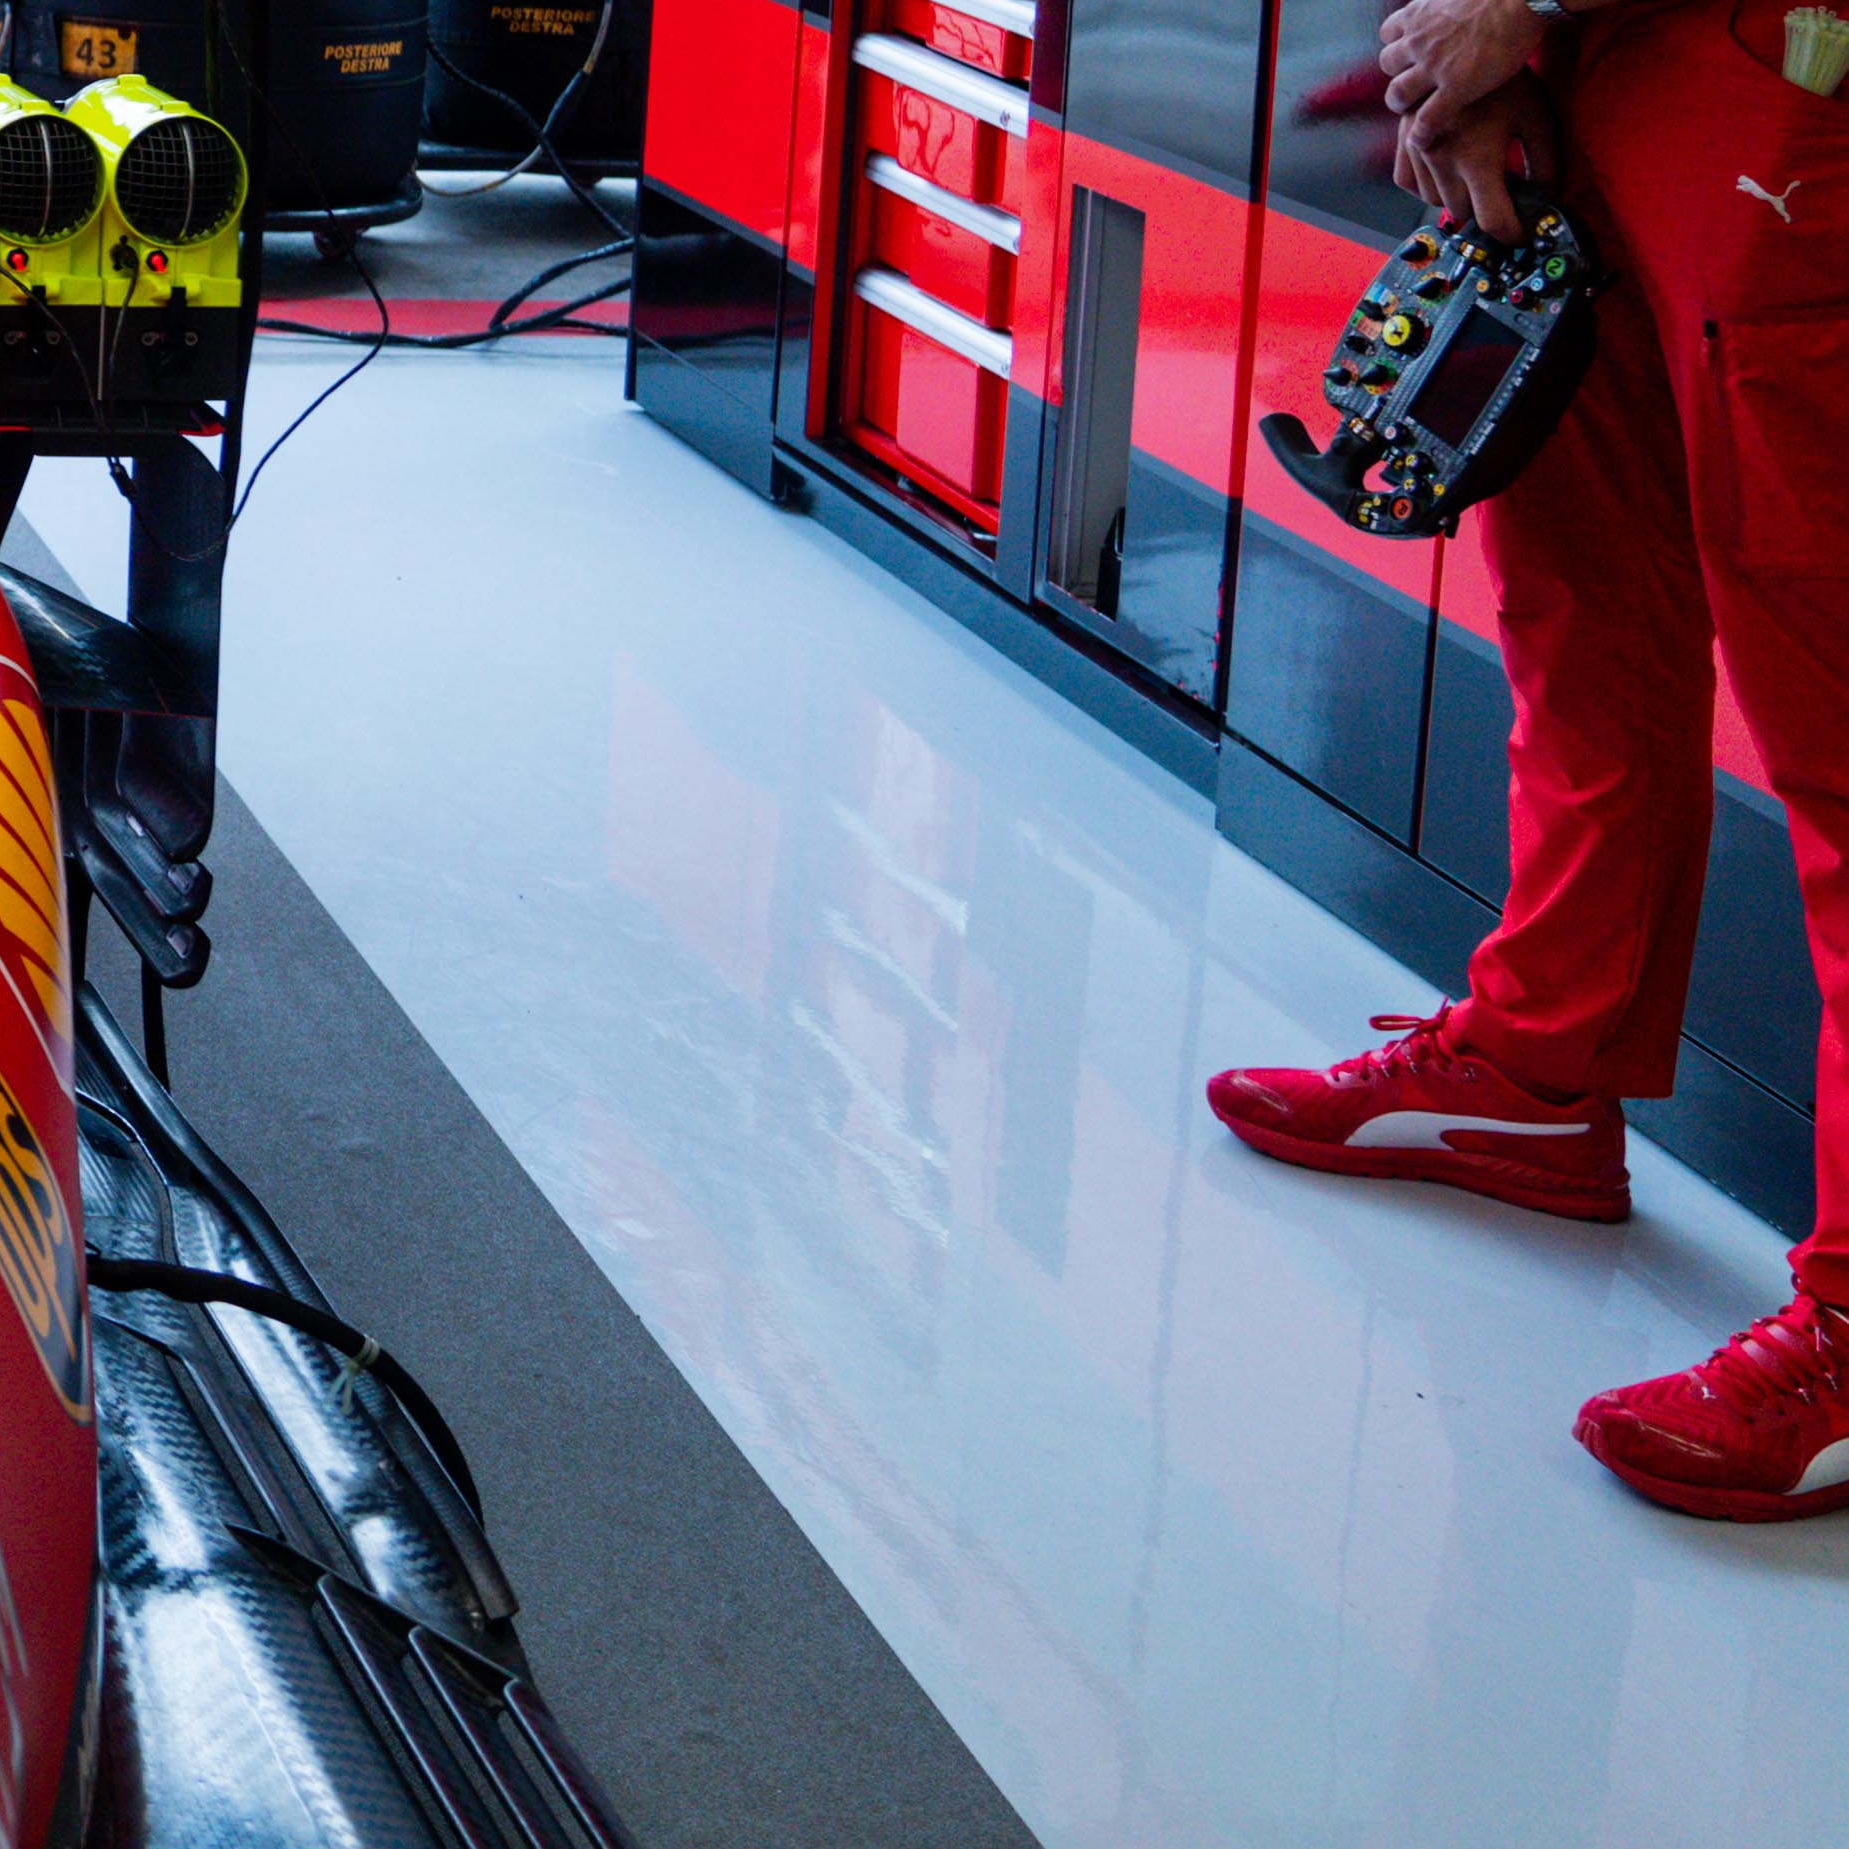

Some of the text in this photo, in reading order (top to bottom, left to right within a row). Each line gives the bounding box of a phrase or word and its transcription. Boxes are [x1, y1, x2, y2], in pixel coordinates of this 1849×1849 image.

[490, 6, 597, 24] POSTERIORE
[509, 21, 575, 36] DESTRA
[75, 37, 118, 69] 43
[324, 39, 404, 61] POSTERIORE
[340, 56, 391, 73] DESTRA
